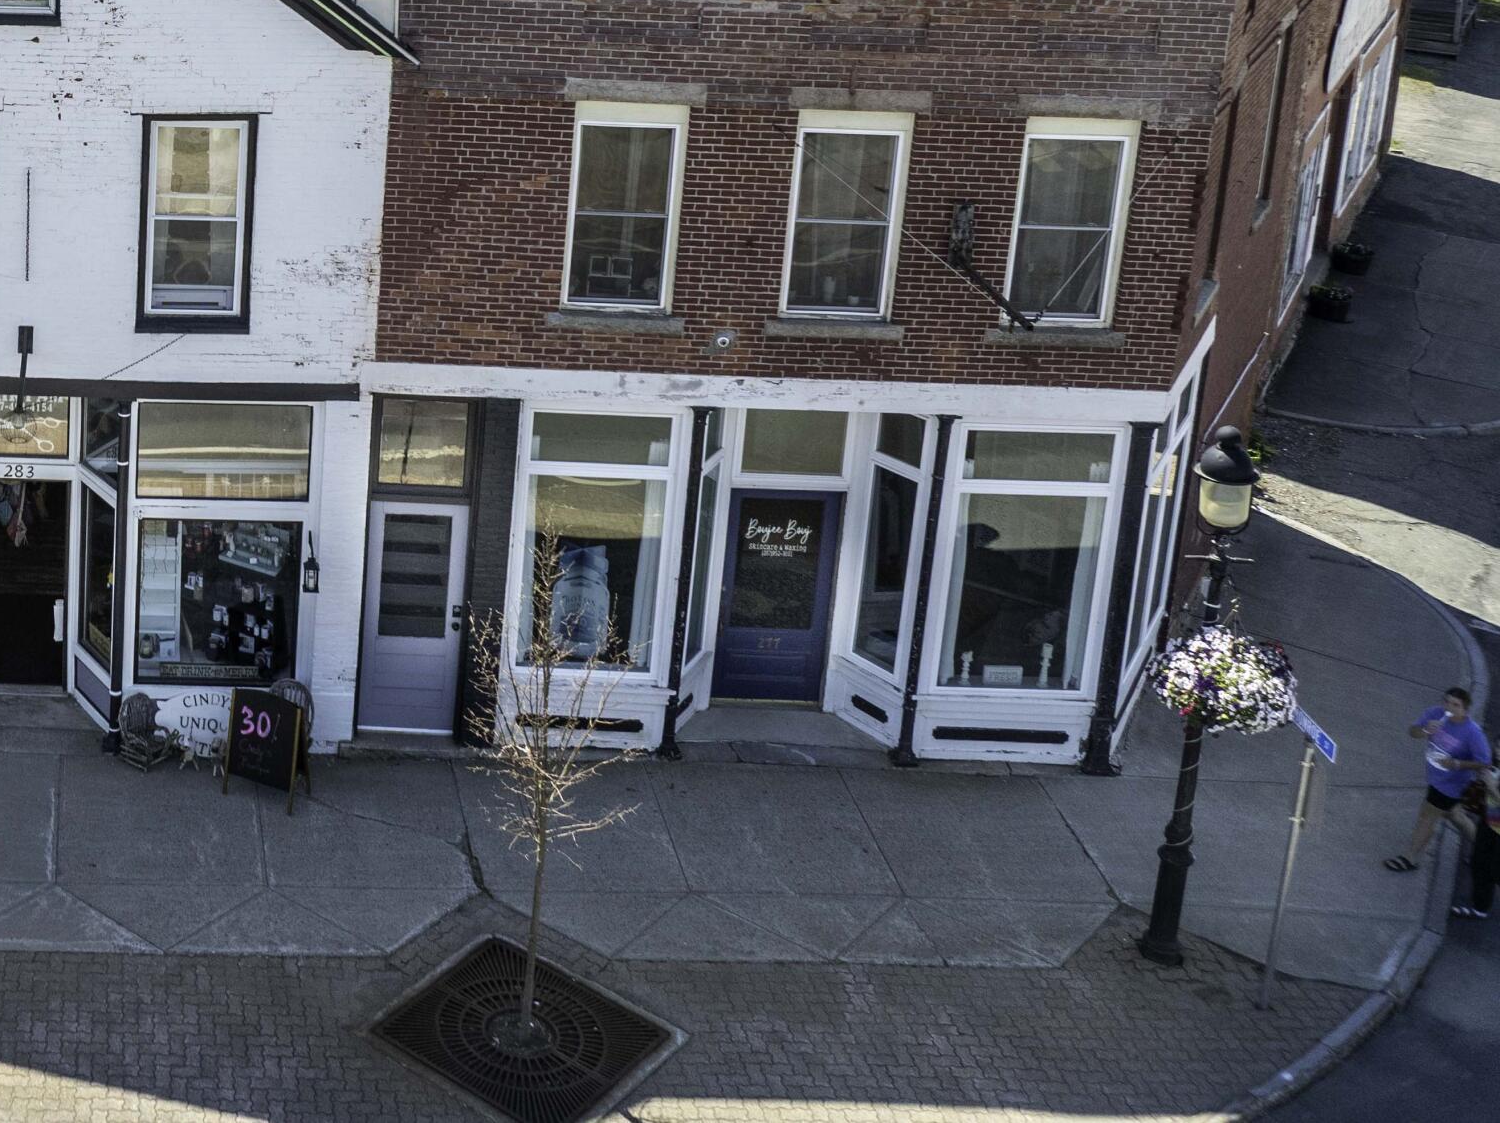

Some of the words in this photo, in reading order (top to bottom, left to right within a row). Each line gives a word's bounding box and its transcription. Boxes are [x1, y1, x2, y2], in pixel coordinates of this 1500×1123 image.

[3, 465, 35, 478] 283
[748, 542, 779, 551] Skincare
[784, 544, 807, 553] Waxing
[180, 716, 228, 734] UNIQU
